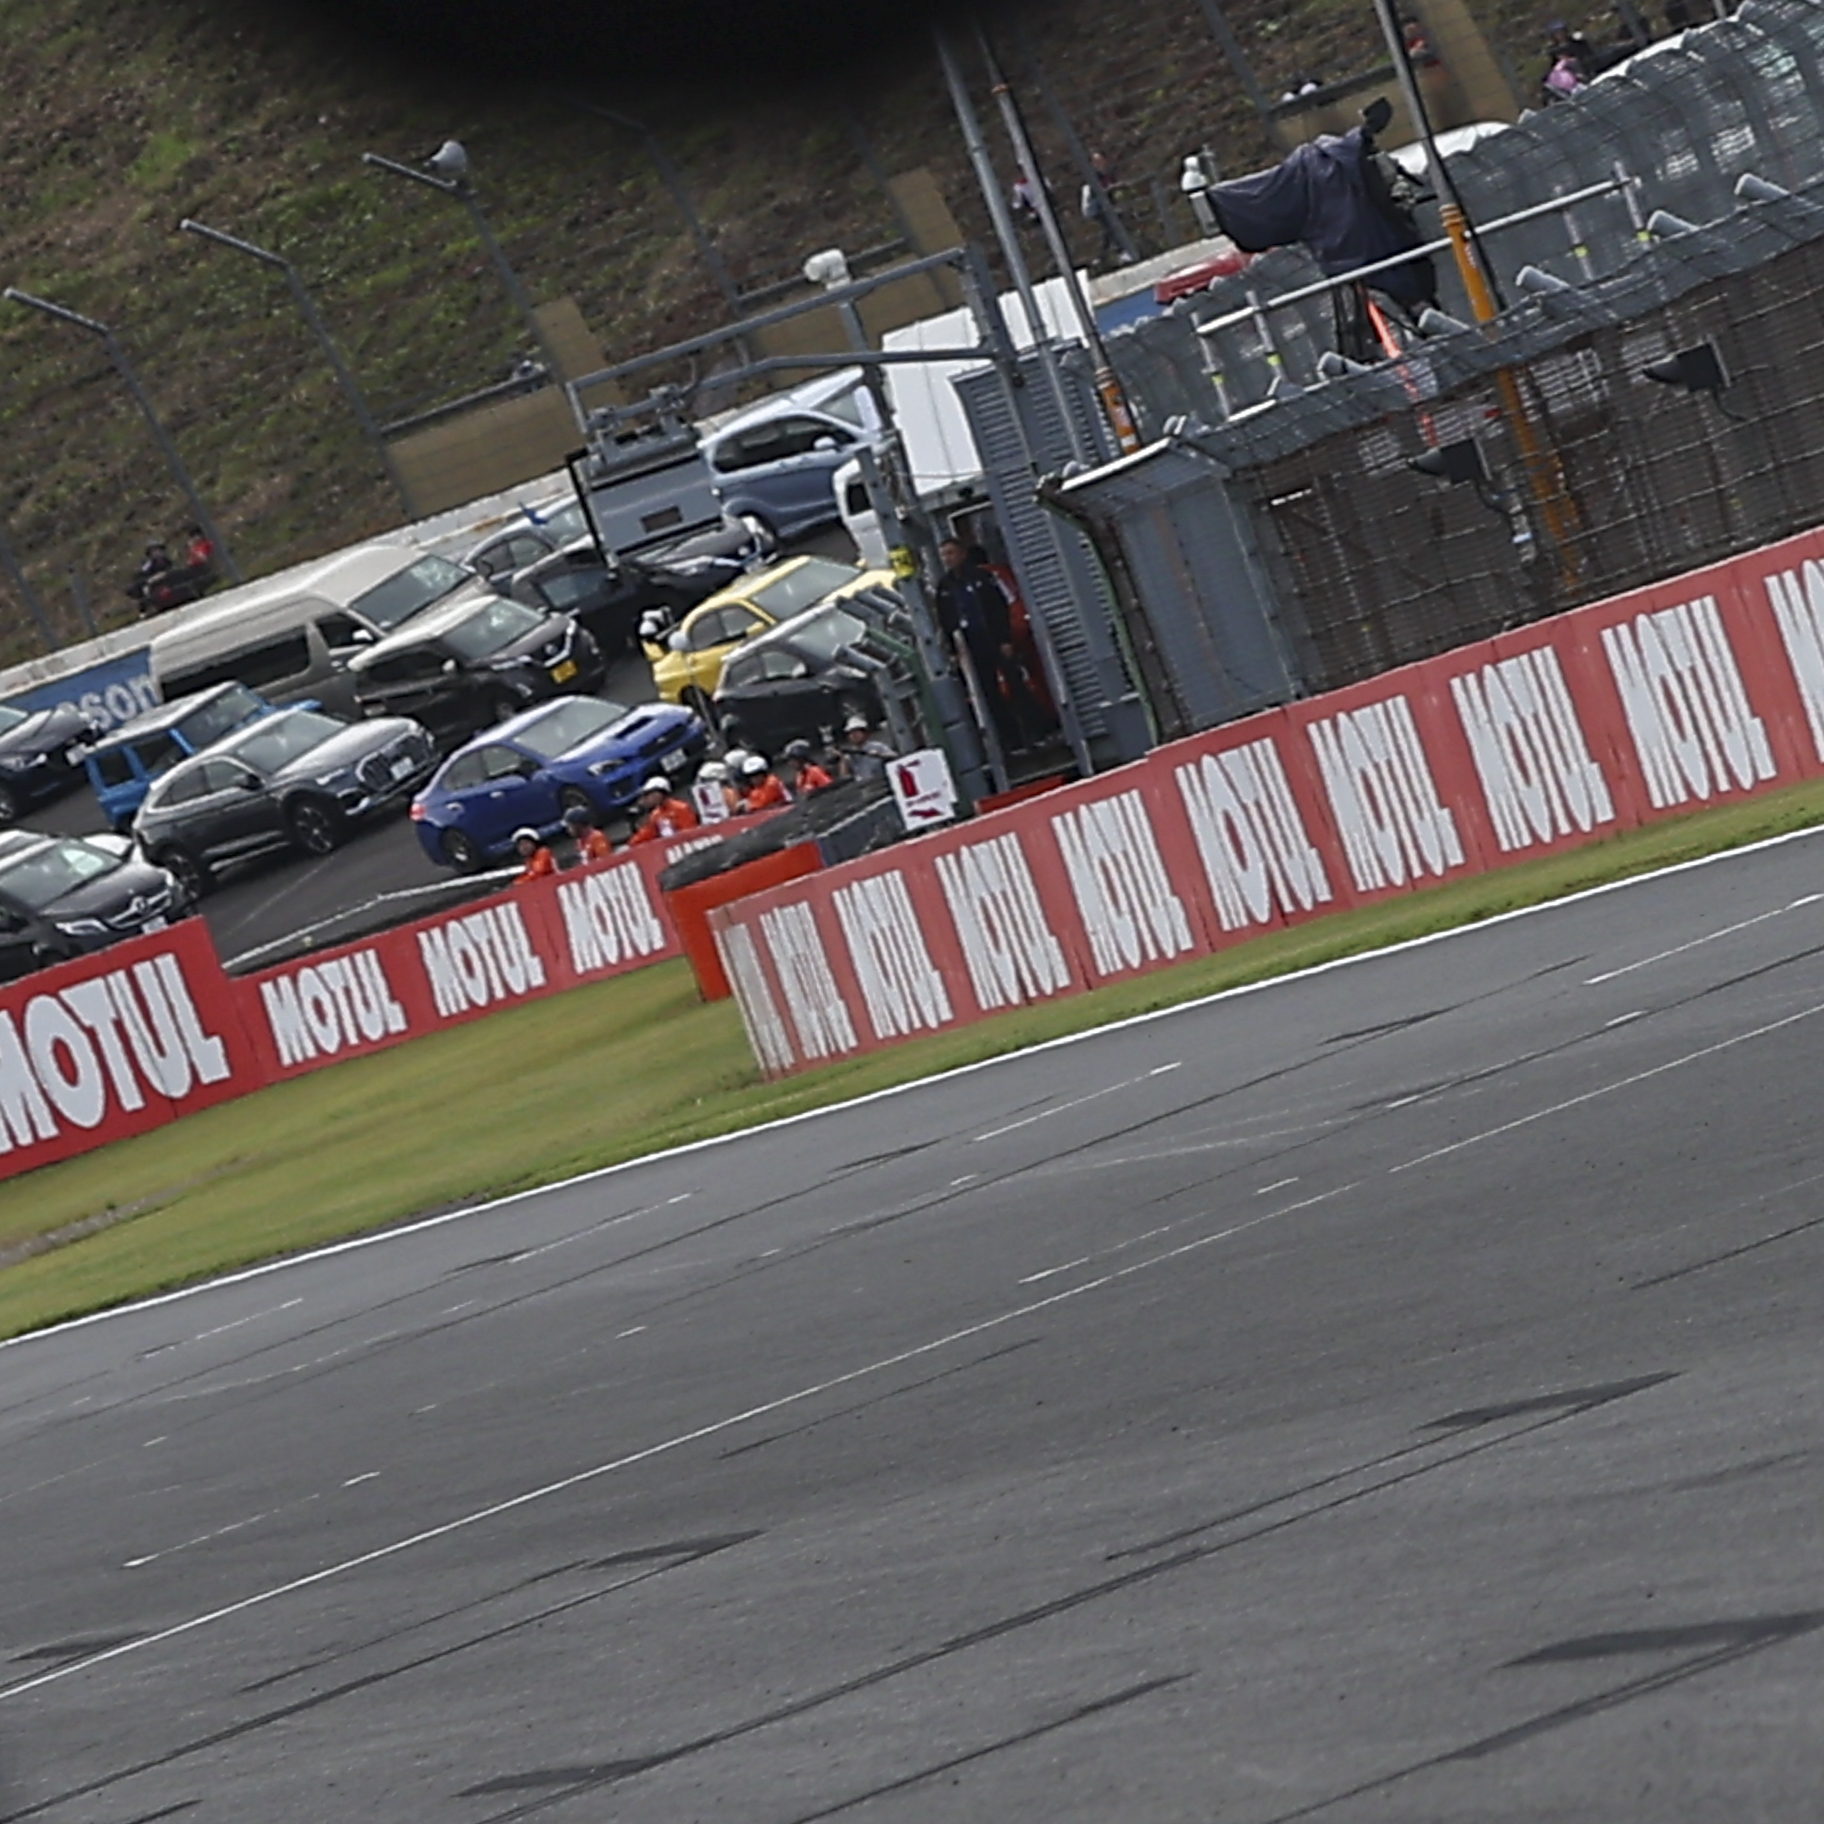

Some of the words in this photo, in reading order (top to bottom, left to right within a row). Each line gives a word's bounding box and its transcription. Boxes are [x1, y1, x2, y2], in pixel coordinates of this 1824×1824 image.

[1307, 695, 1464, 892] MOTUL
[1450, 646, 1615, 851] MOTUL
[1601, 595, 1777, 808] MOTUL
[557, 860, 665, 974] MOTUL
[1051, 788, 1194, 976] MOTUL
[1175, 738, 1333, 932] MOTUL
[0, 953, 231, 1154] MOTUL
[261, 949, 408, 1065] MOTUL
[418, 902, 546, 1016] MOTUL
